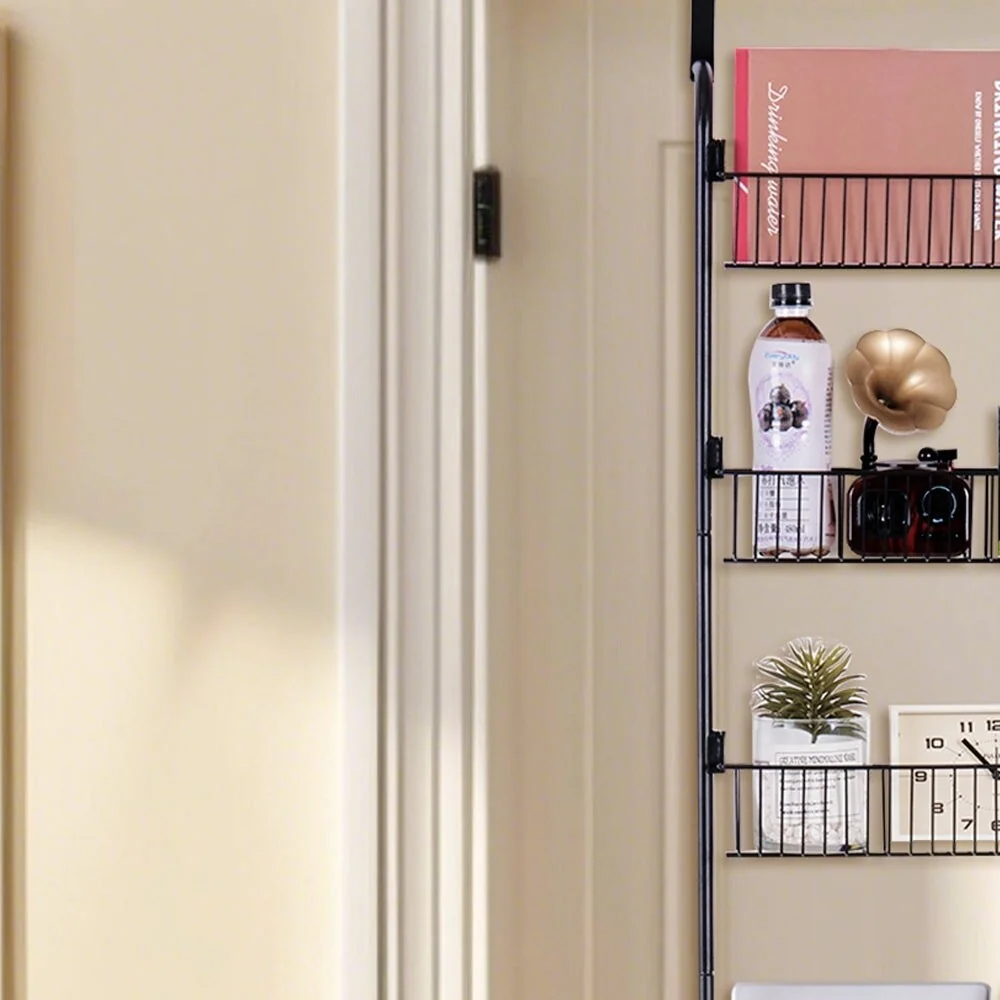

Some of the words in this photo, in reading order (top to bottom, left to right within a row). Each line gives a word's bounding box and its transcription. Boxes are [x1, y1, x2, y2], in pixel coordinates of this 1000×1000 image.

[761, 82, 789, 175] Drinking
[959, 721, 974, 733] 11
[925, 738, 944, 749] 10
[914, 771, 928, 782] 9
[932, 803, 944, 814] 8
[961, 819, 974, 830] 7
